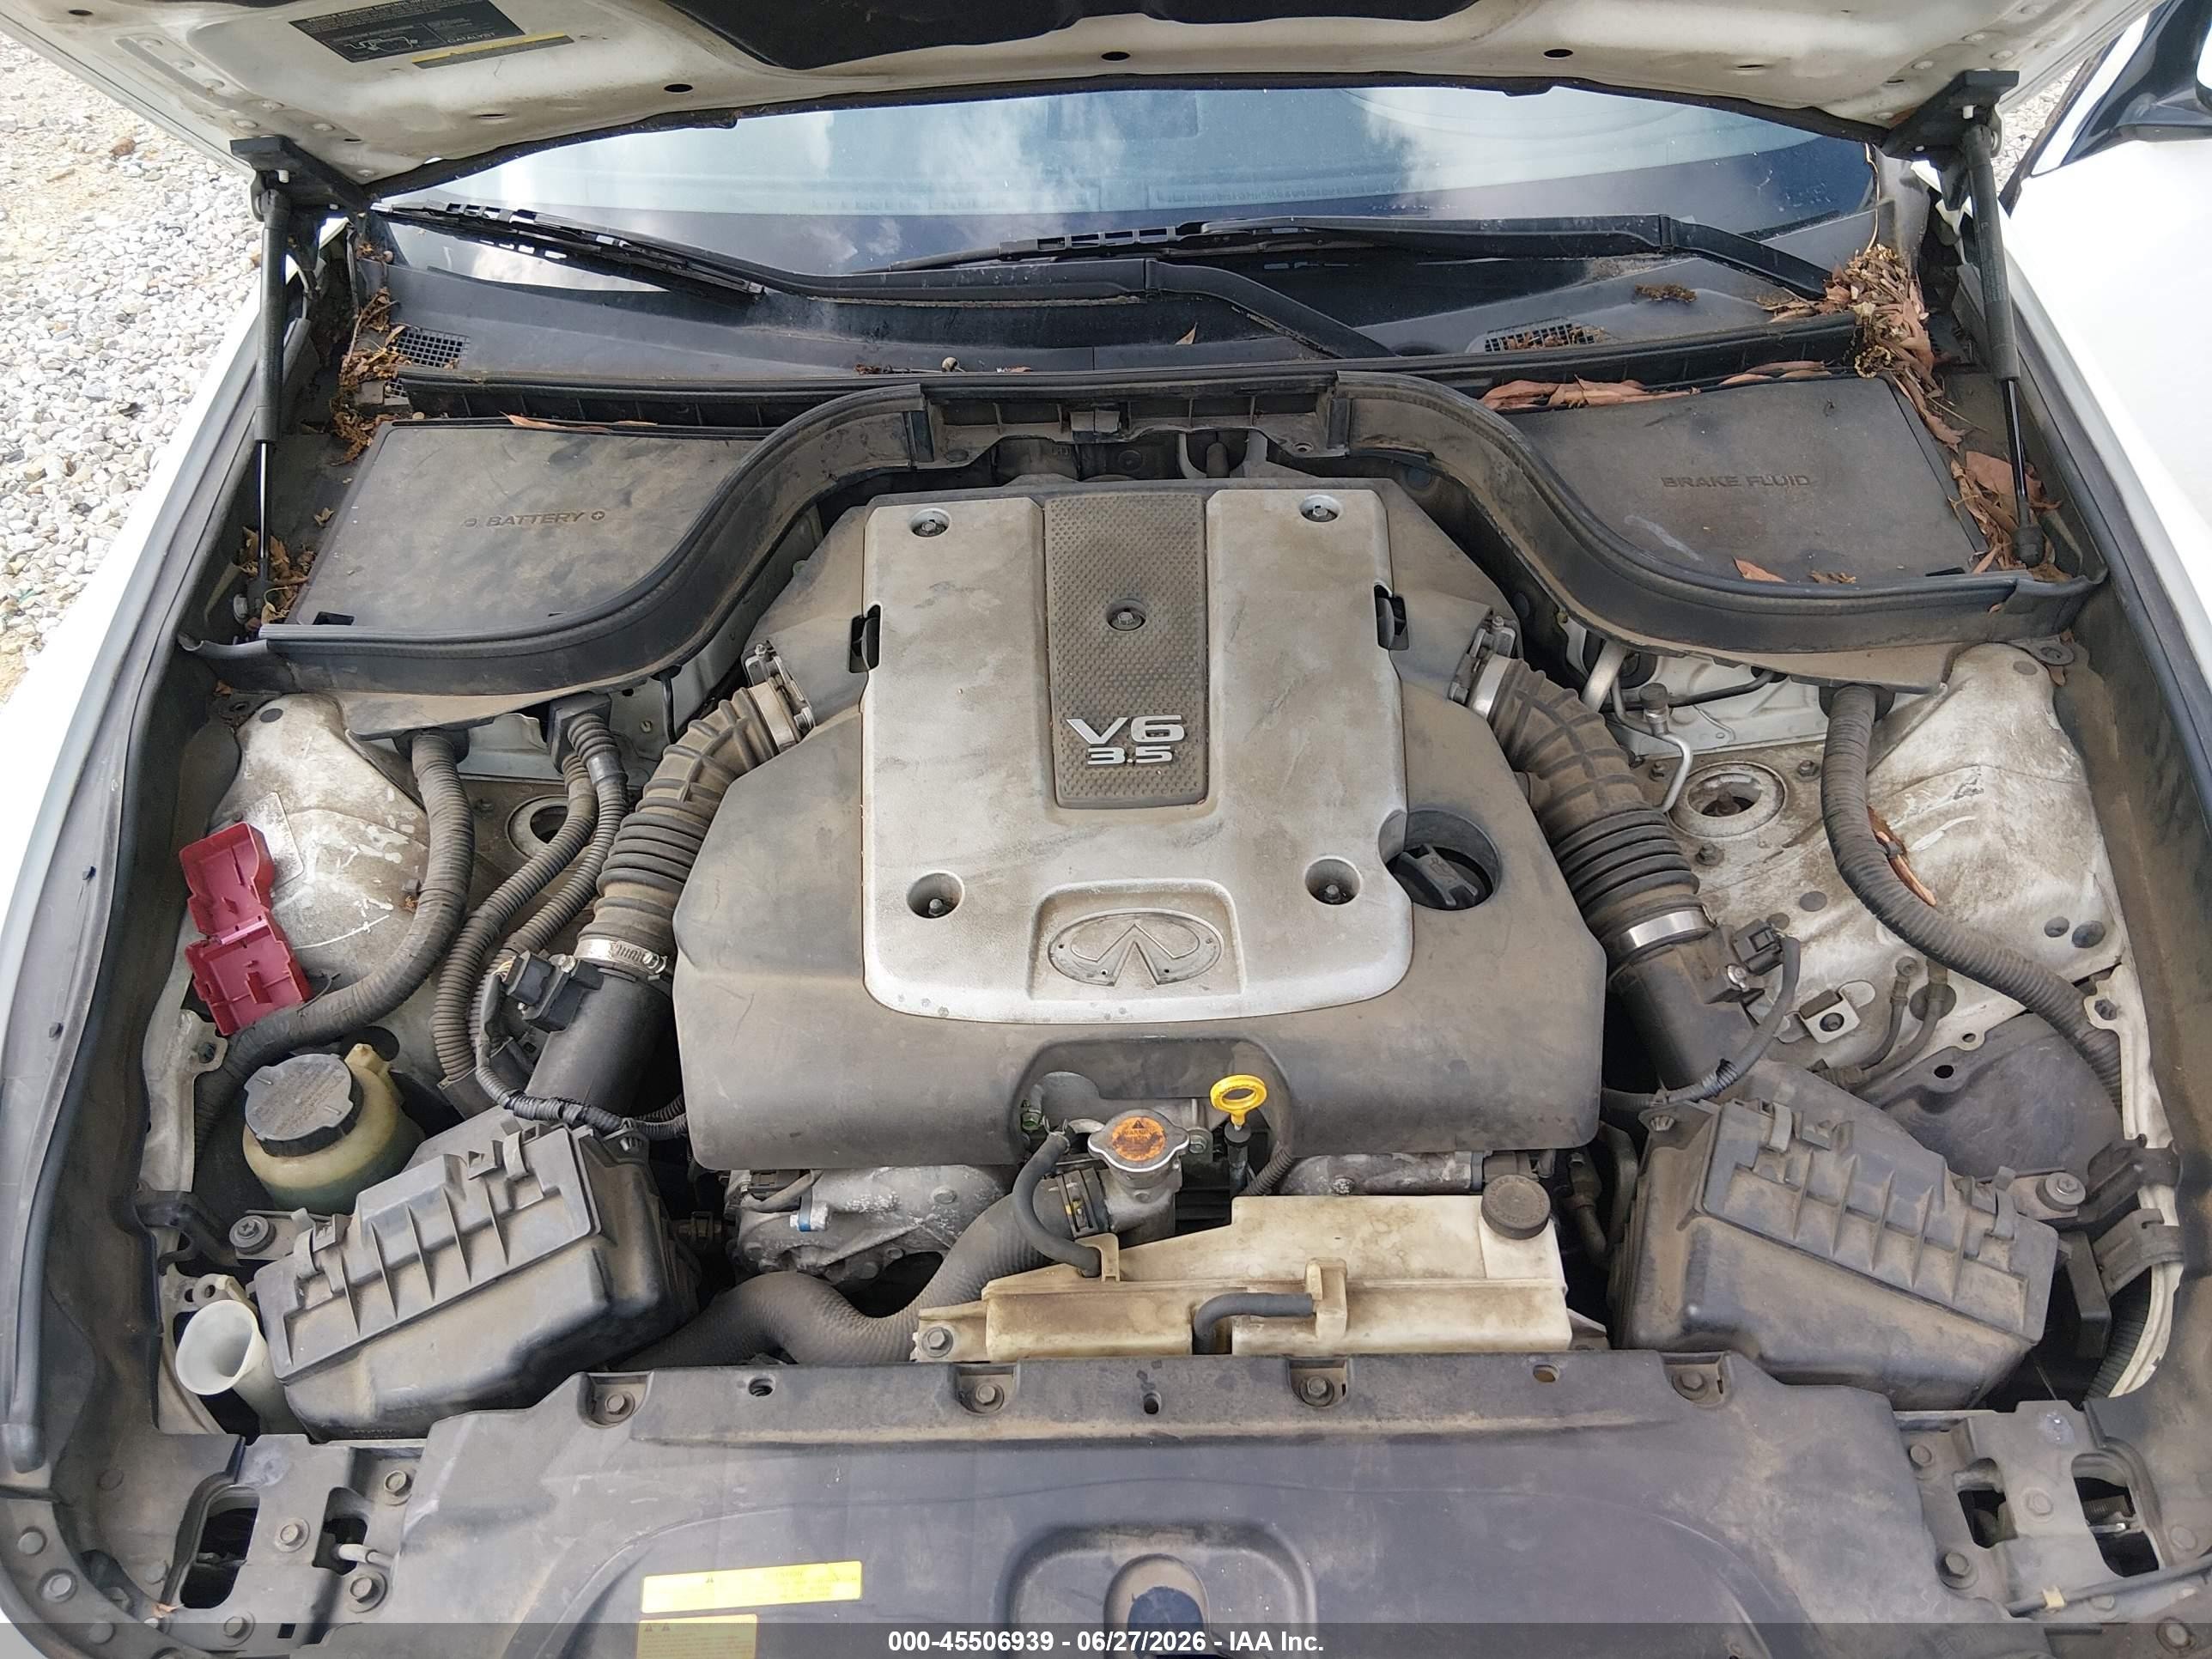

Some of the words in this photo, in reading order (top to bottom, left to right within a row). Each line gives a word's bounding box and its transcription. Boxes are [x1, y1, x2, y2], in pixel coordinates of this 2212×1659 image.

[447, 32, 495, 44] CATALYST
[1662, 475, 1739, 487] BRAKE
[1747, 474, 1810, 487] FLUID
[486, 512, 585, 527] BATTERY
[1066, 714, 1185, 744] V6
[1087, 745, 1173, 765] 3.5
